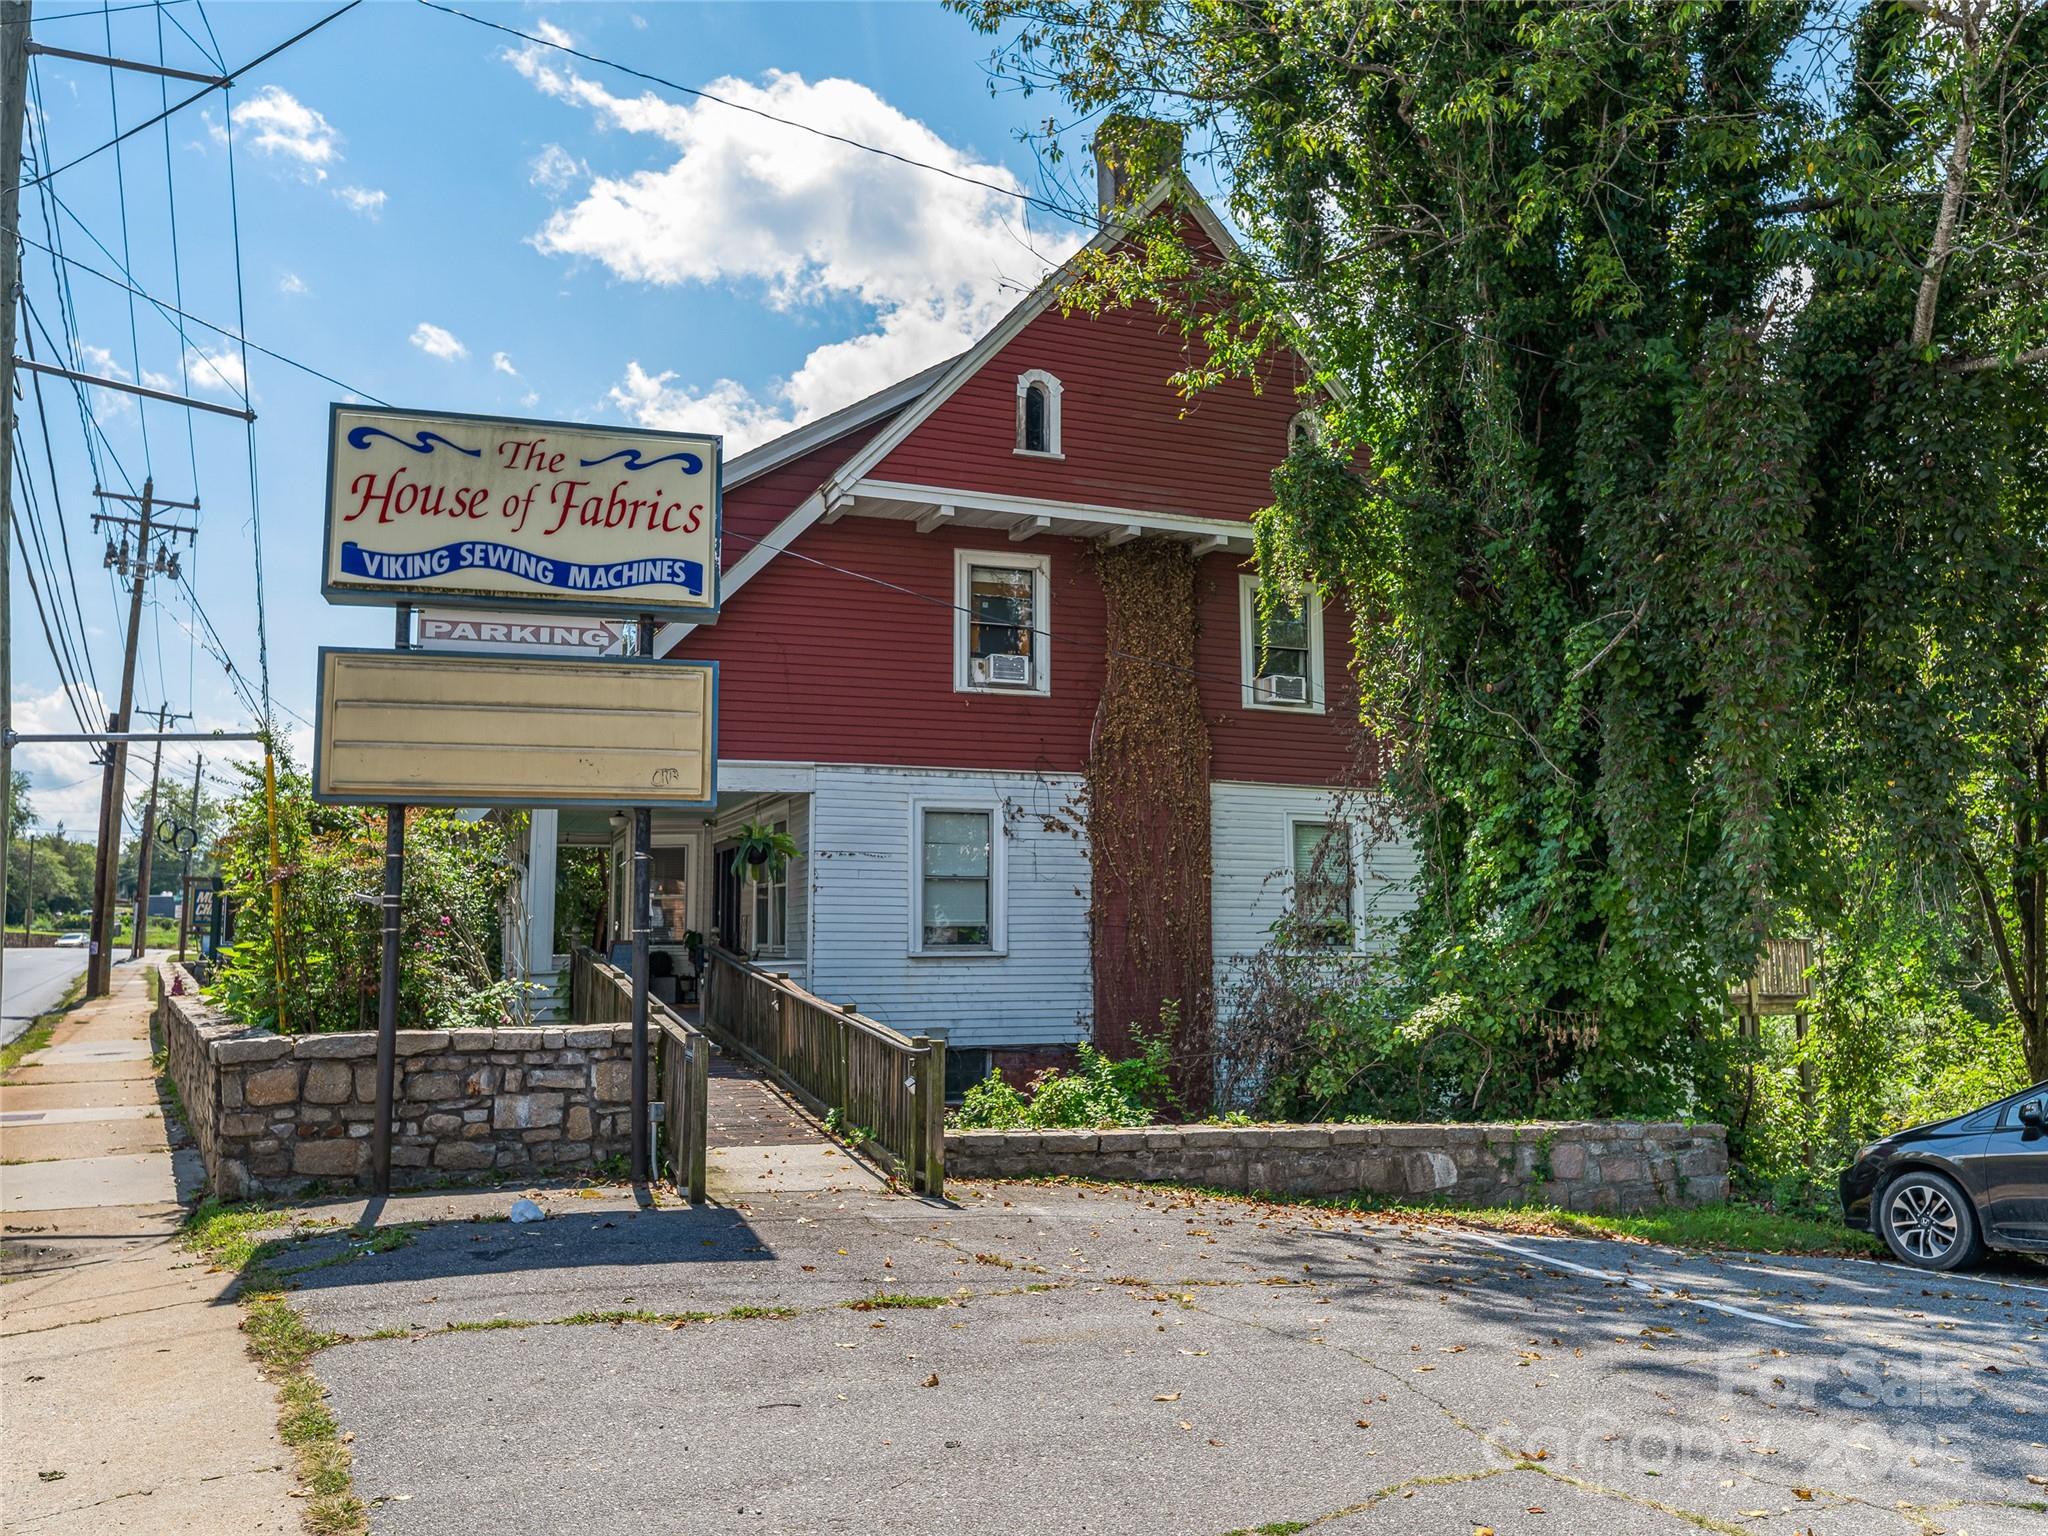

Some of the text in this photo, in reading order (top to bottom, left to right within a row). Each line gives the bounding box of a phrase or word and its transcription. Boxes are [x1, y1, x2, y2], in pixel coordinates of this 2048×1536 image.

[498, 438, 566, 473] The
[343, 466, 704, 535] House of Fabrics
[362, 543, 686, 589] VIKING SEWING MACHINES
[425, 620, 610, 646] PARKING
